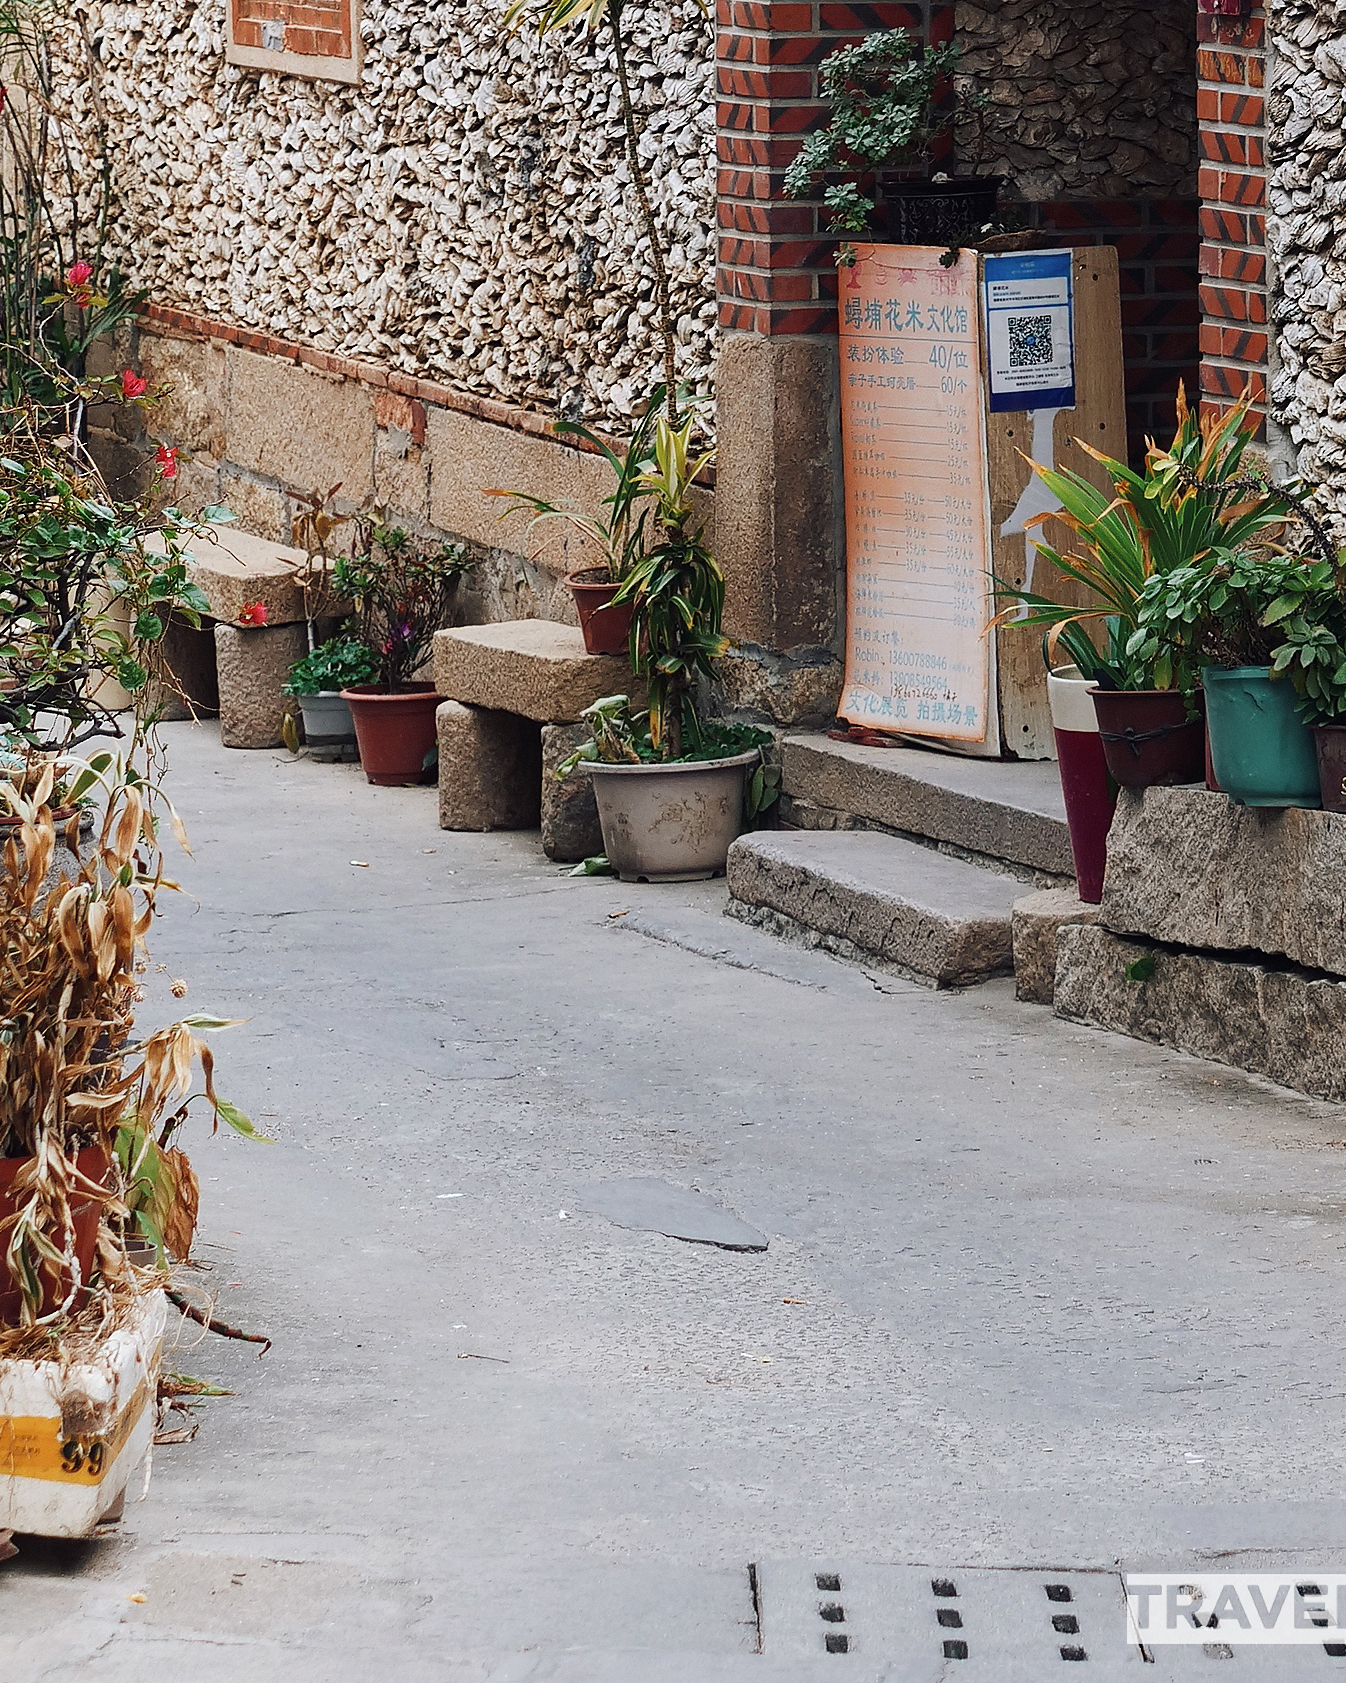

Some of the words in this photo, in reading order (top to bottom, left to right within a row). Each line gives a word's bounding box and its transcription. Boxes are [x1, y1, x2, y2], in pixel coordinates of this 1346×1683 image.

[845, 297, 968, 334] 蟳埔花米文化馆
[847, 344, 905, 365] 装扮体验
[929, 344, 969, 373] 40/位
[941, 375, 968, 396] 60/个
[846, 690, 909, 718] 文化展览
[916, 699, 978, 727] 拍摄场景
